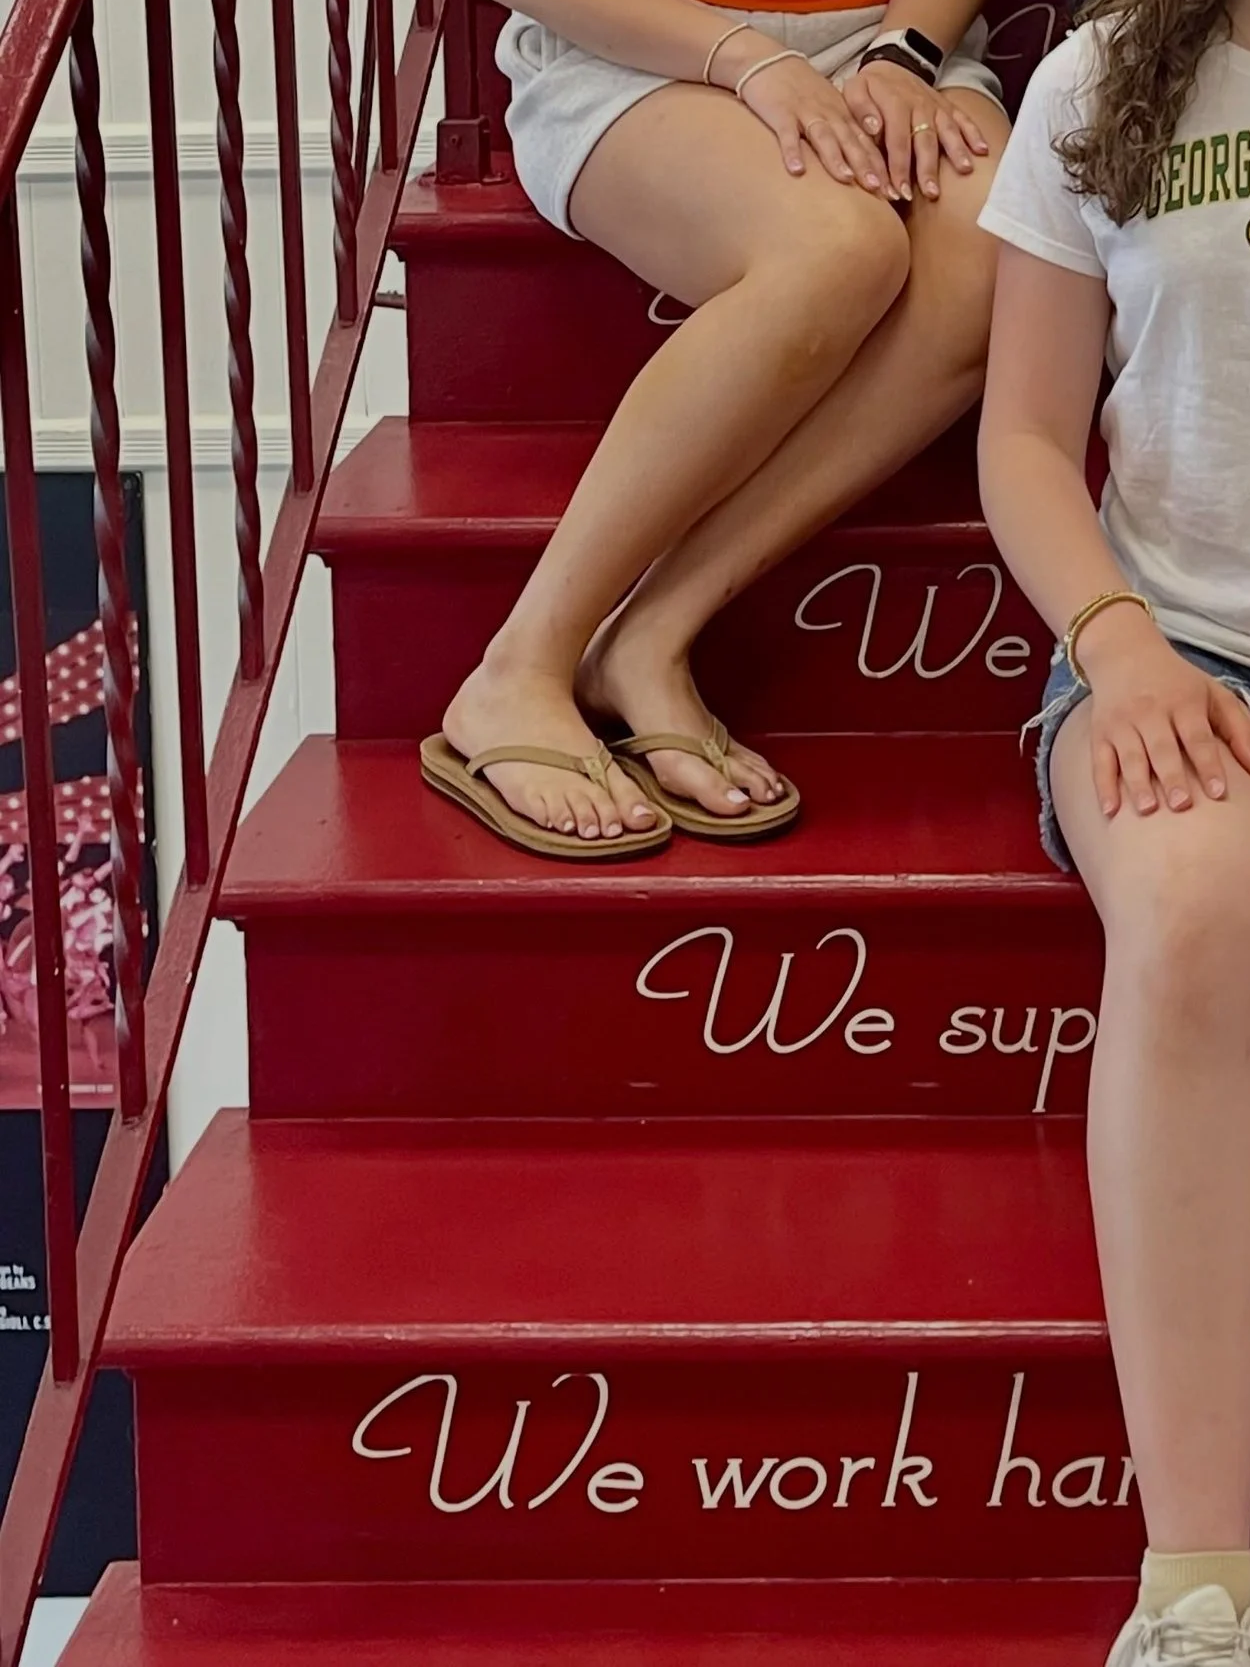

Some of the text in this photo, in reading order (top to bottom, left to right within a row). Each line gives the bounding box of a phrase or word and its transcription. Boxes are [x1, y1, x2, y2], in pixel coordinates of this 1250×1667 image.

[794, 563, 1031, 679] We
[635, 926, 1098, 1114] We sup
[351, 1370, 1136, 1514] We work har
